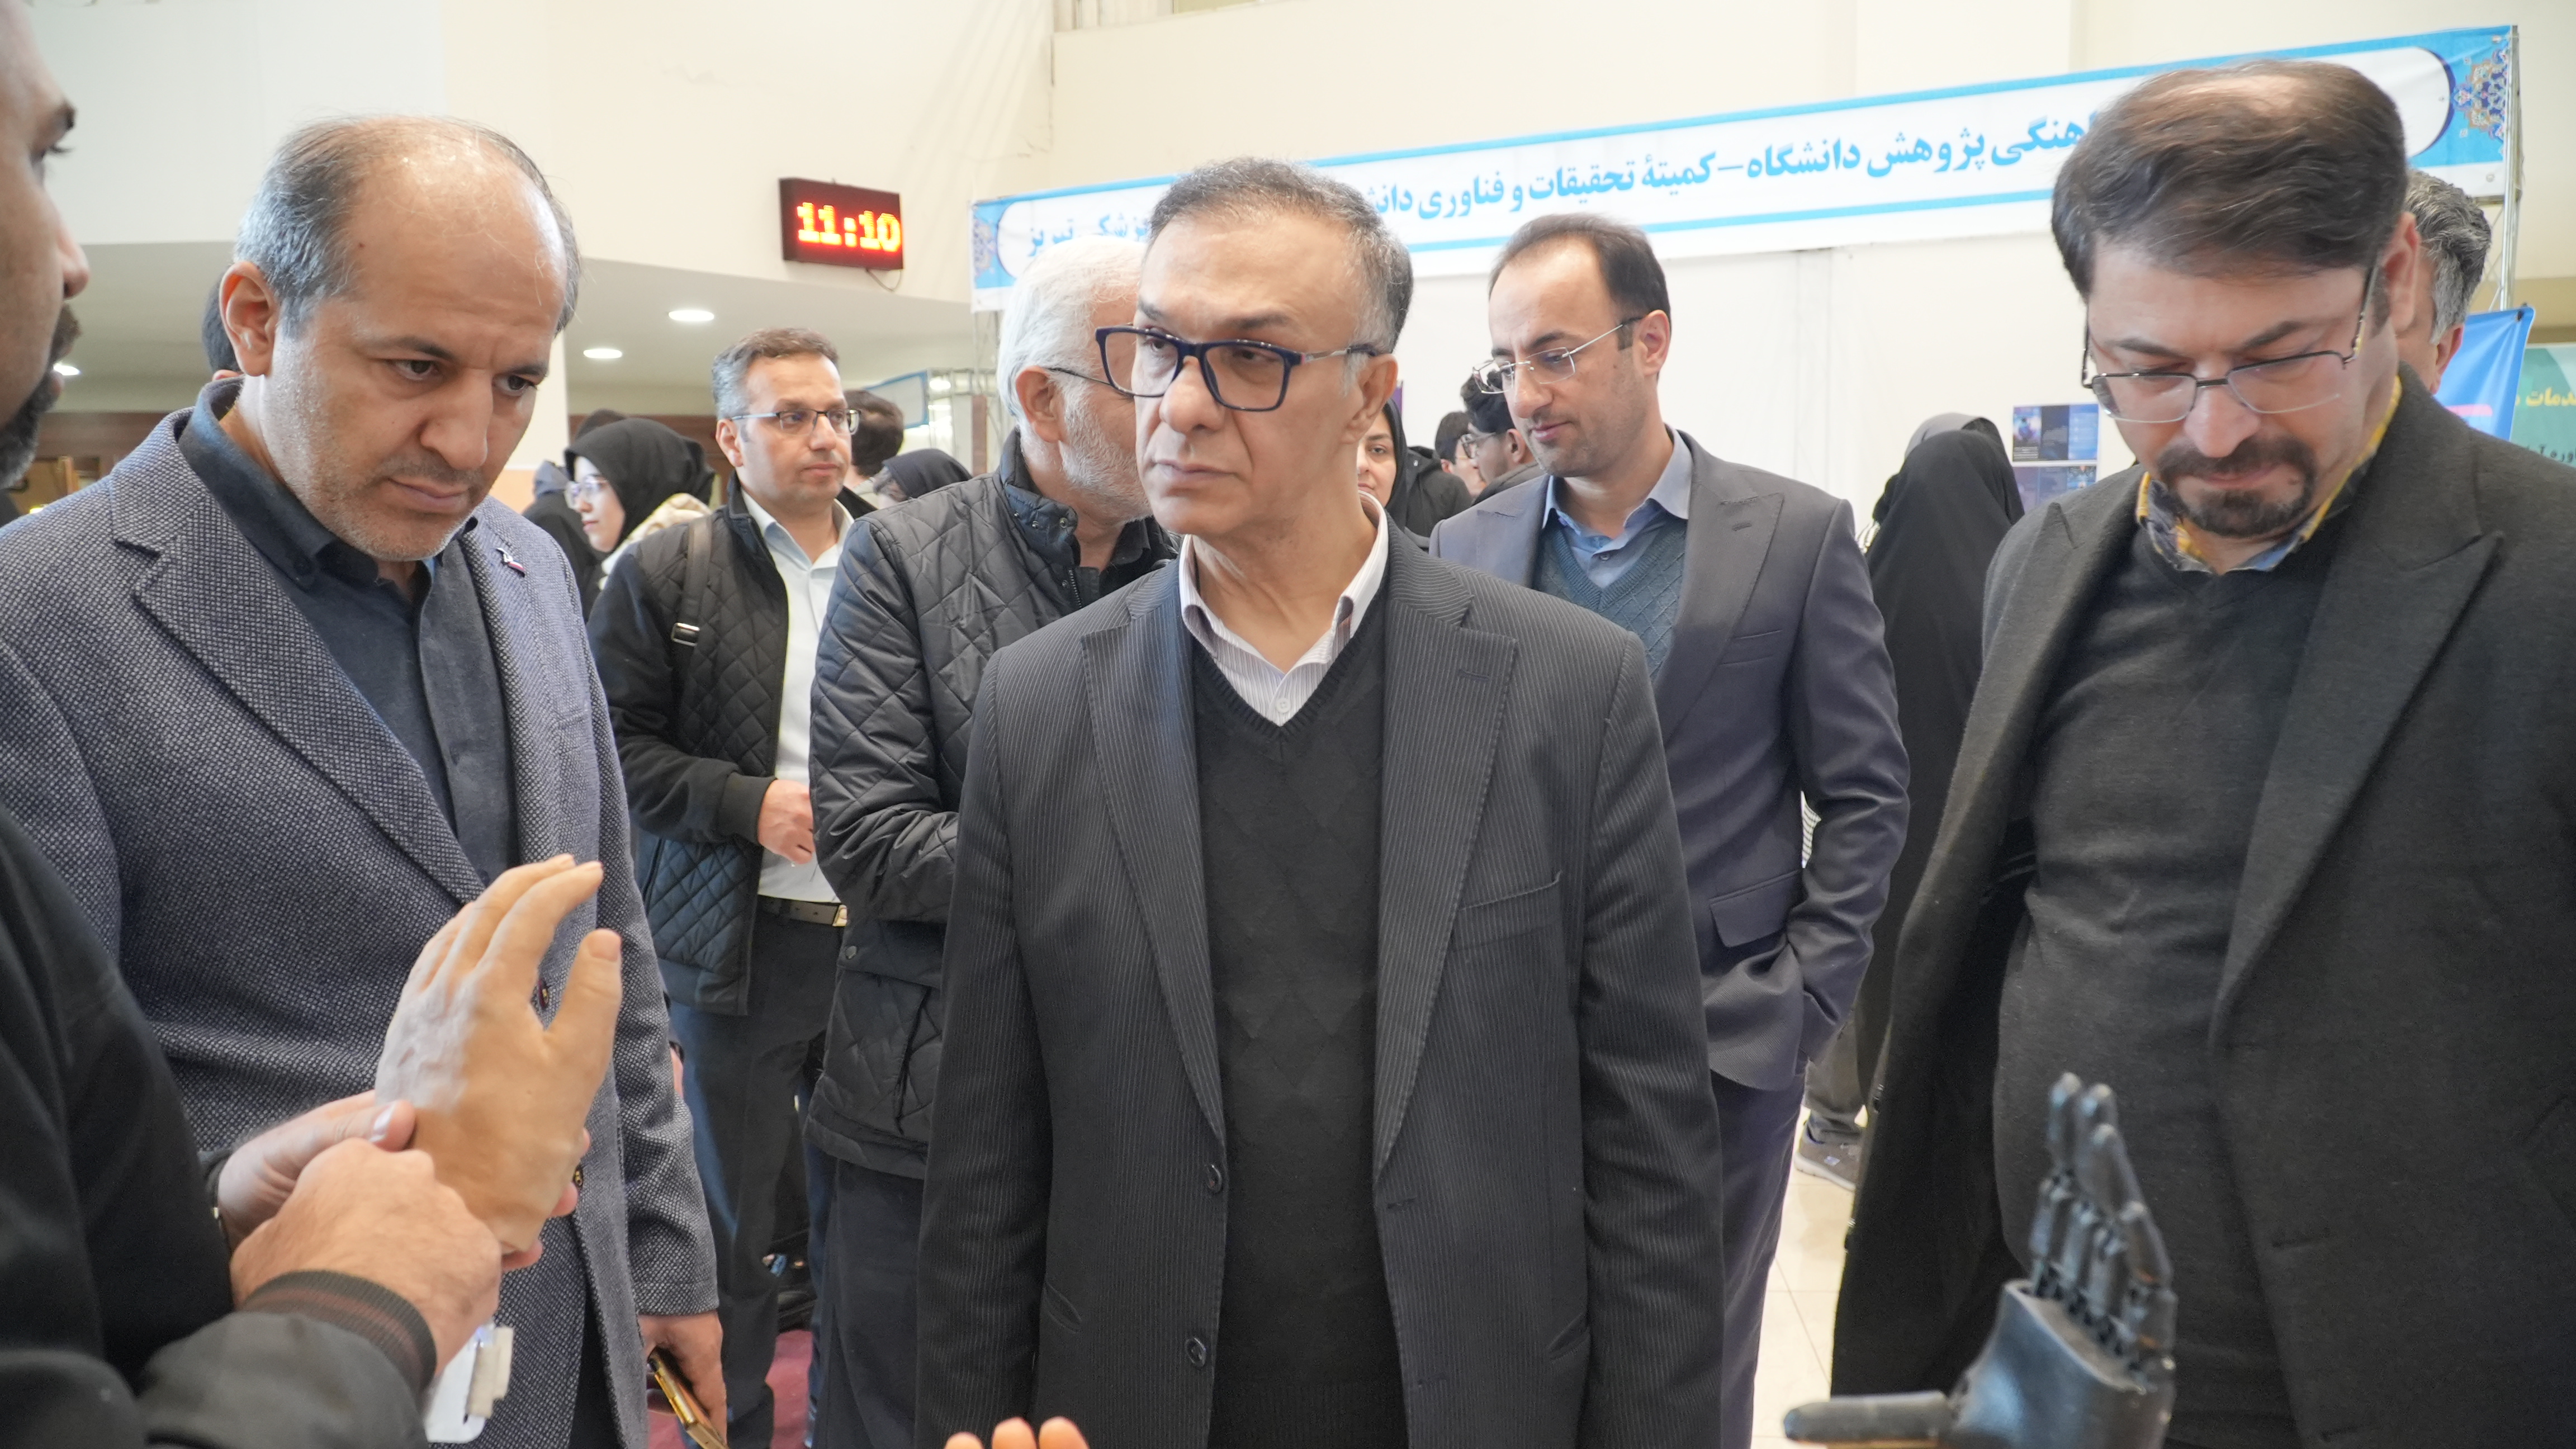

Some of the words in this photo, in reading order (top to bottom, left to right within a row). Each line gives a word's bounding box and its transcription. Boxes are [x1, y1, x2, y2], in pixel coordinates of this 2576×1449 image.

[1747, 138, 1861, 178] دانشگاه
[1867, 127, 1985, 178] پژوهش
[1418, 171, 1505, 220] فناوری
[1509, 184, 1523, 212] و
[1529, 160, 1635, 205] تحقیقات
[797, 202, 901, 252] 11:10
